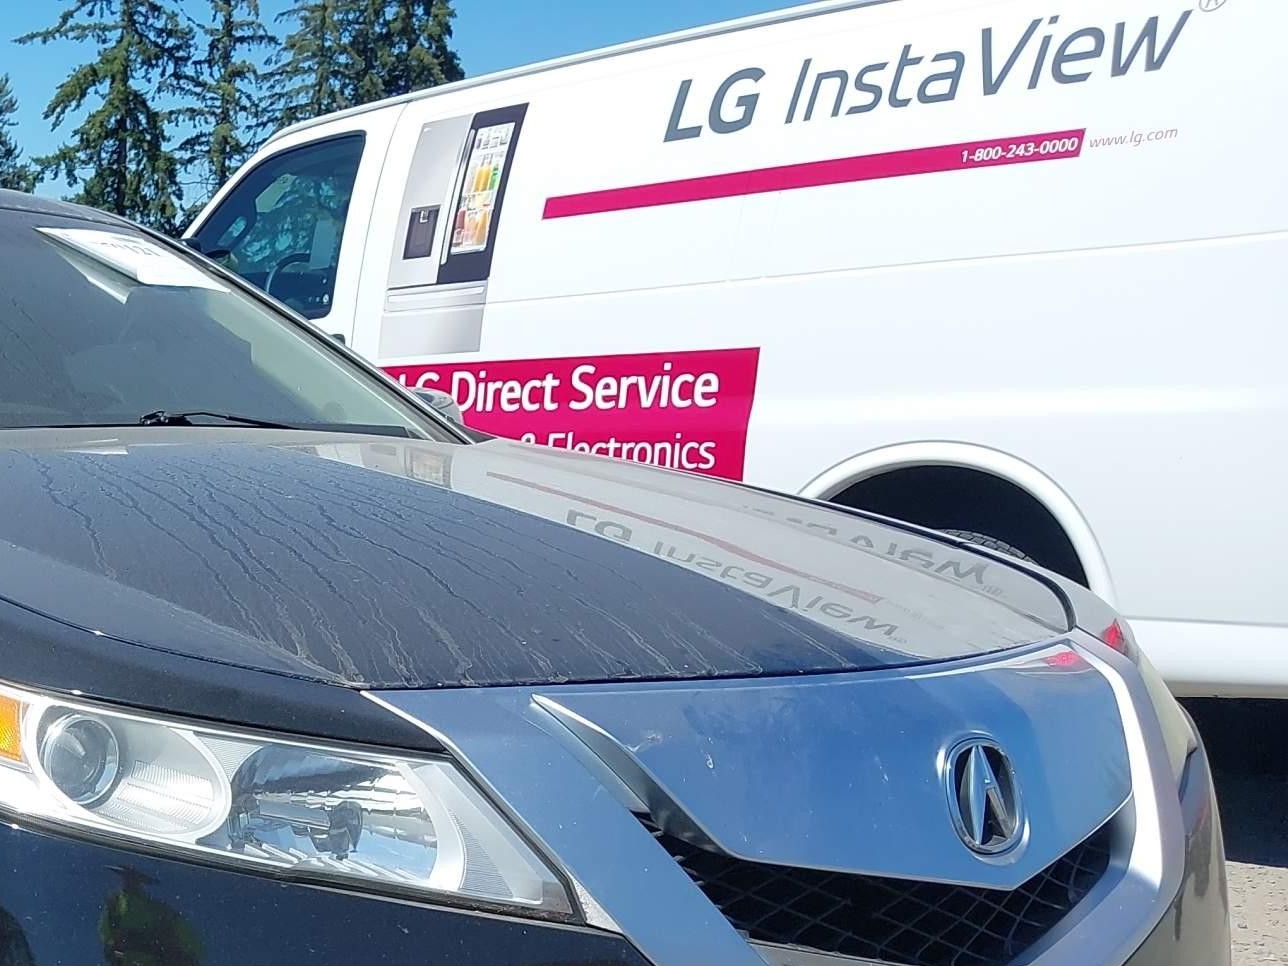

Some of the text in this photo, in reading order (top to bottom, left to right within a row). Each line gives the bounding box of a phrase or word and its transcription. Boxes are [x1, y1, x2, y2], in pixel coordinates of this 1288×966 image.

[663, 9, 1195, 143] LG InstaView
[961, 137, 1079, 163] 1-800-243-0000
[1089, 128, 1179, 149] www.lg.com
[452, 362, 720, 412] Direct Service
